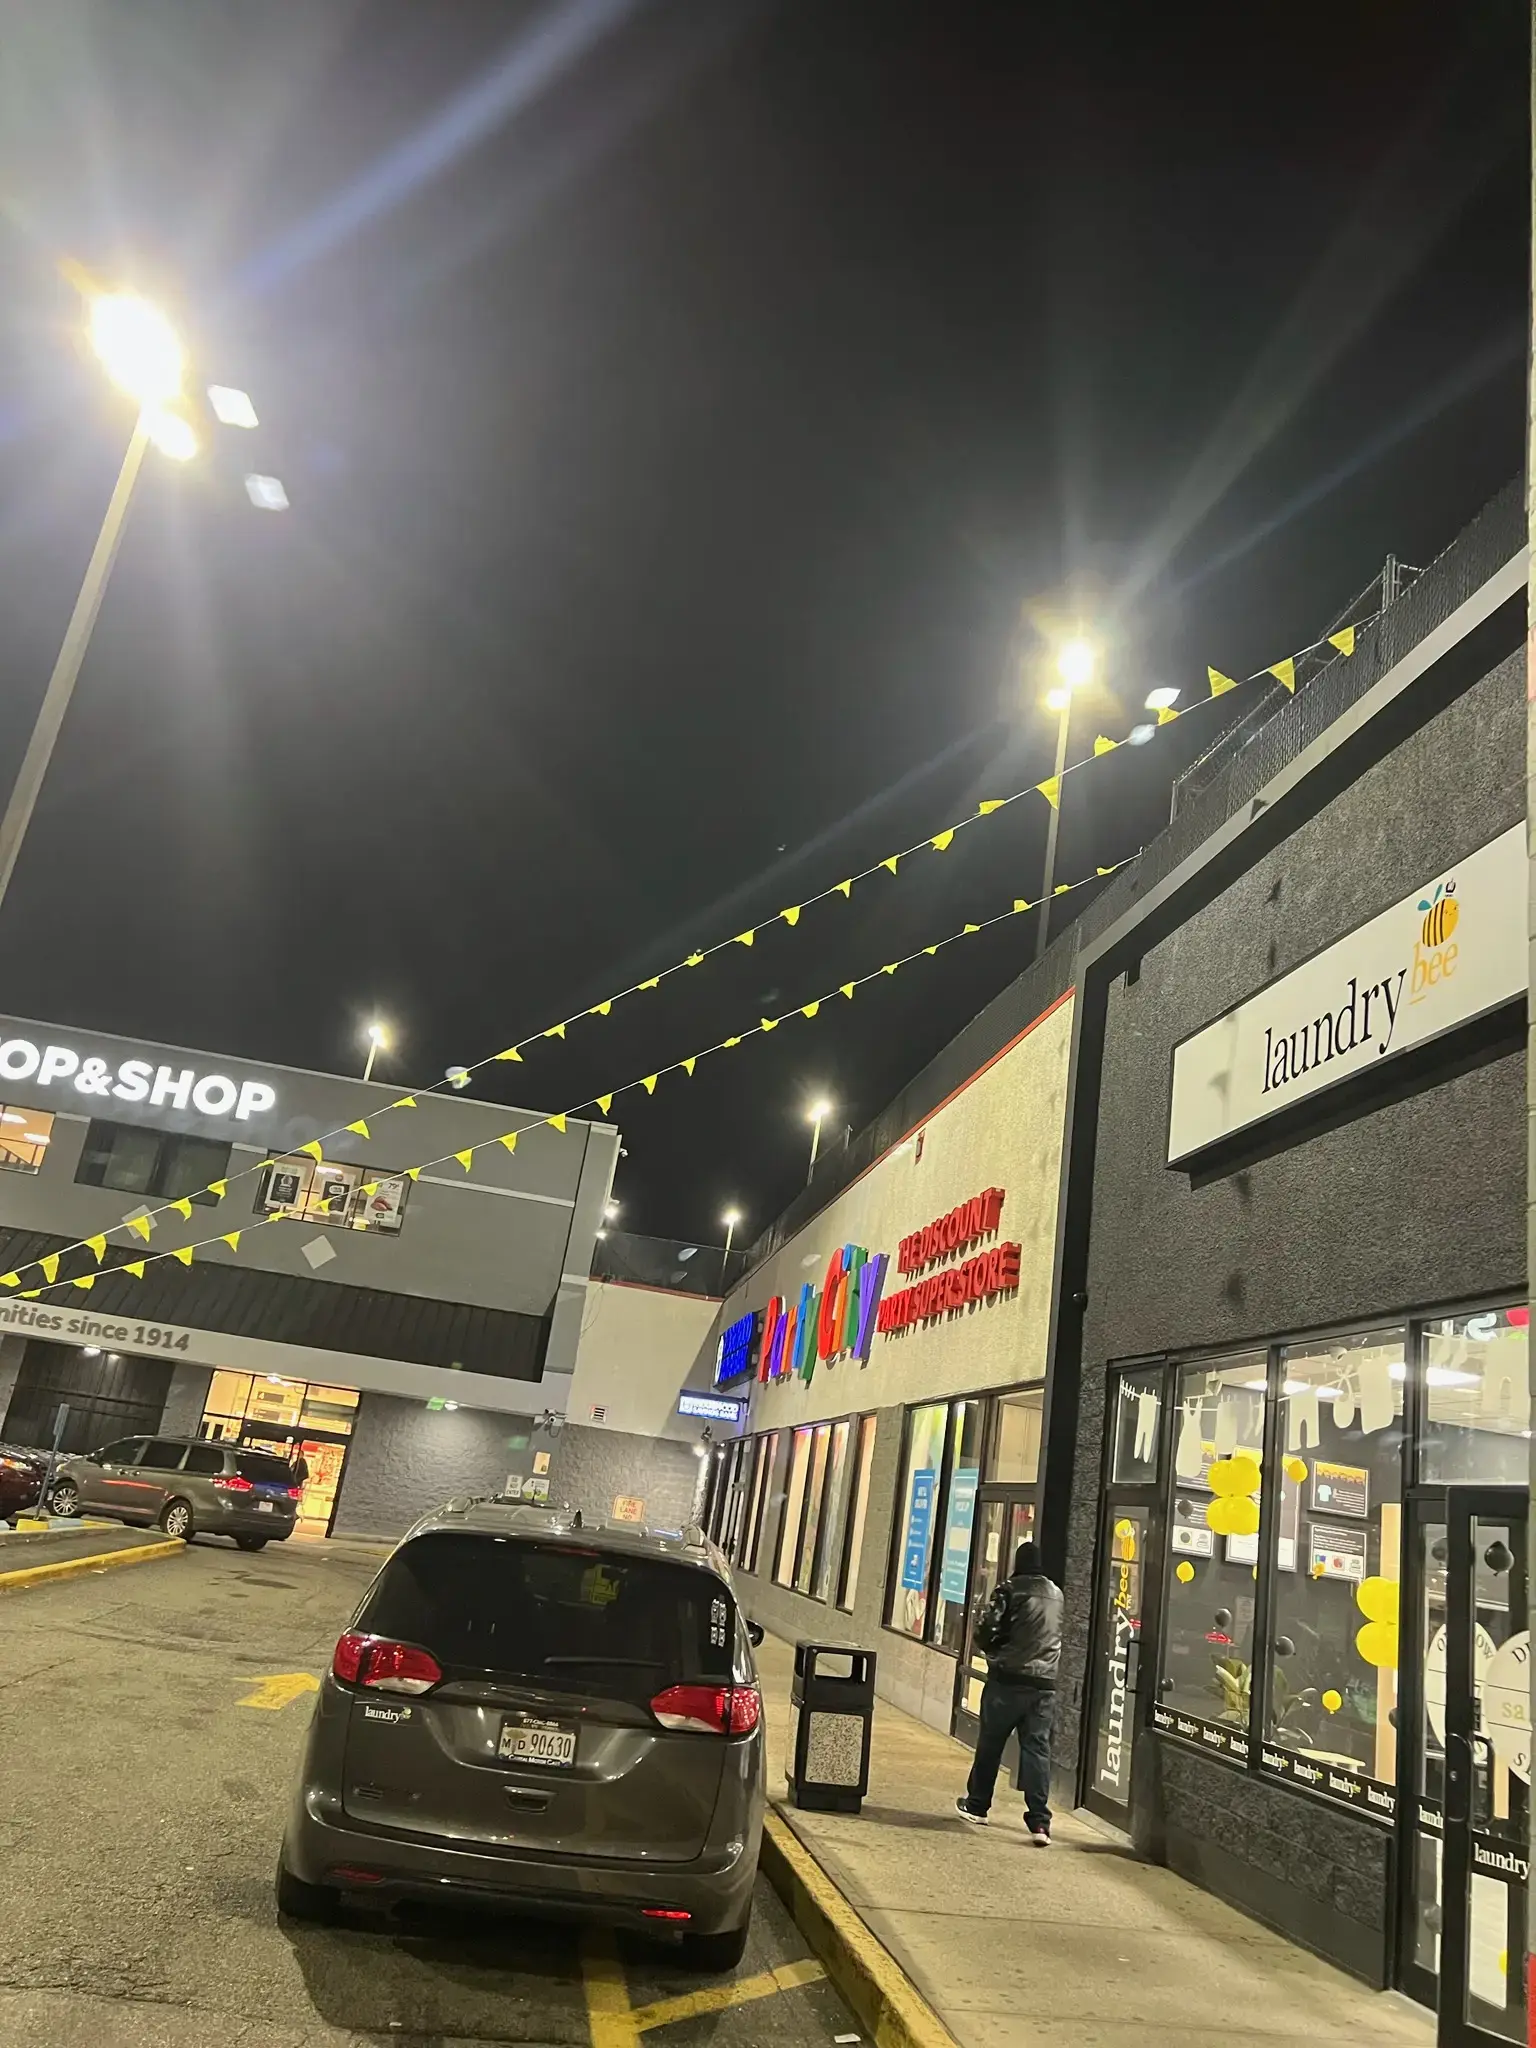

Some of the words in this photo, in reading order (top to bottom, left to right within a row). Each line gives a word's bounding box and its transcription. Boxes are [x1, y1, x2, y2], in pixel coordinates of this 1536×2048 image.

[1261, 968, 1407, 1093] laundry
[1410, 940, 1458, 996] bee
[898, 1231, 926, 1274] THE
[920, 1187, 1006, 1261] DISCOUNT
[817, 1243, 890, 1361] City
[877, 1286, 917, 1333] PARTY
[67, 1315, 128, 1342] since
[133, 1326, 190, 1352] 1914
[620, 1507, 637, 1515] LANE
[622, 1500, 636, 1508] FIRE
[1114, 1564, 1129, 1609] bee
[365, 1705, 402, 1724] laundry
[1101, 1607, 1135, 1786] laundry
[530, 1734, 571, 1758] 90630
[1368, 1785, 1395, 1813] laundry
[1474, 1842, 1530, 1880] laundry
